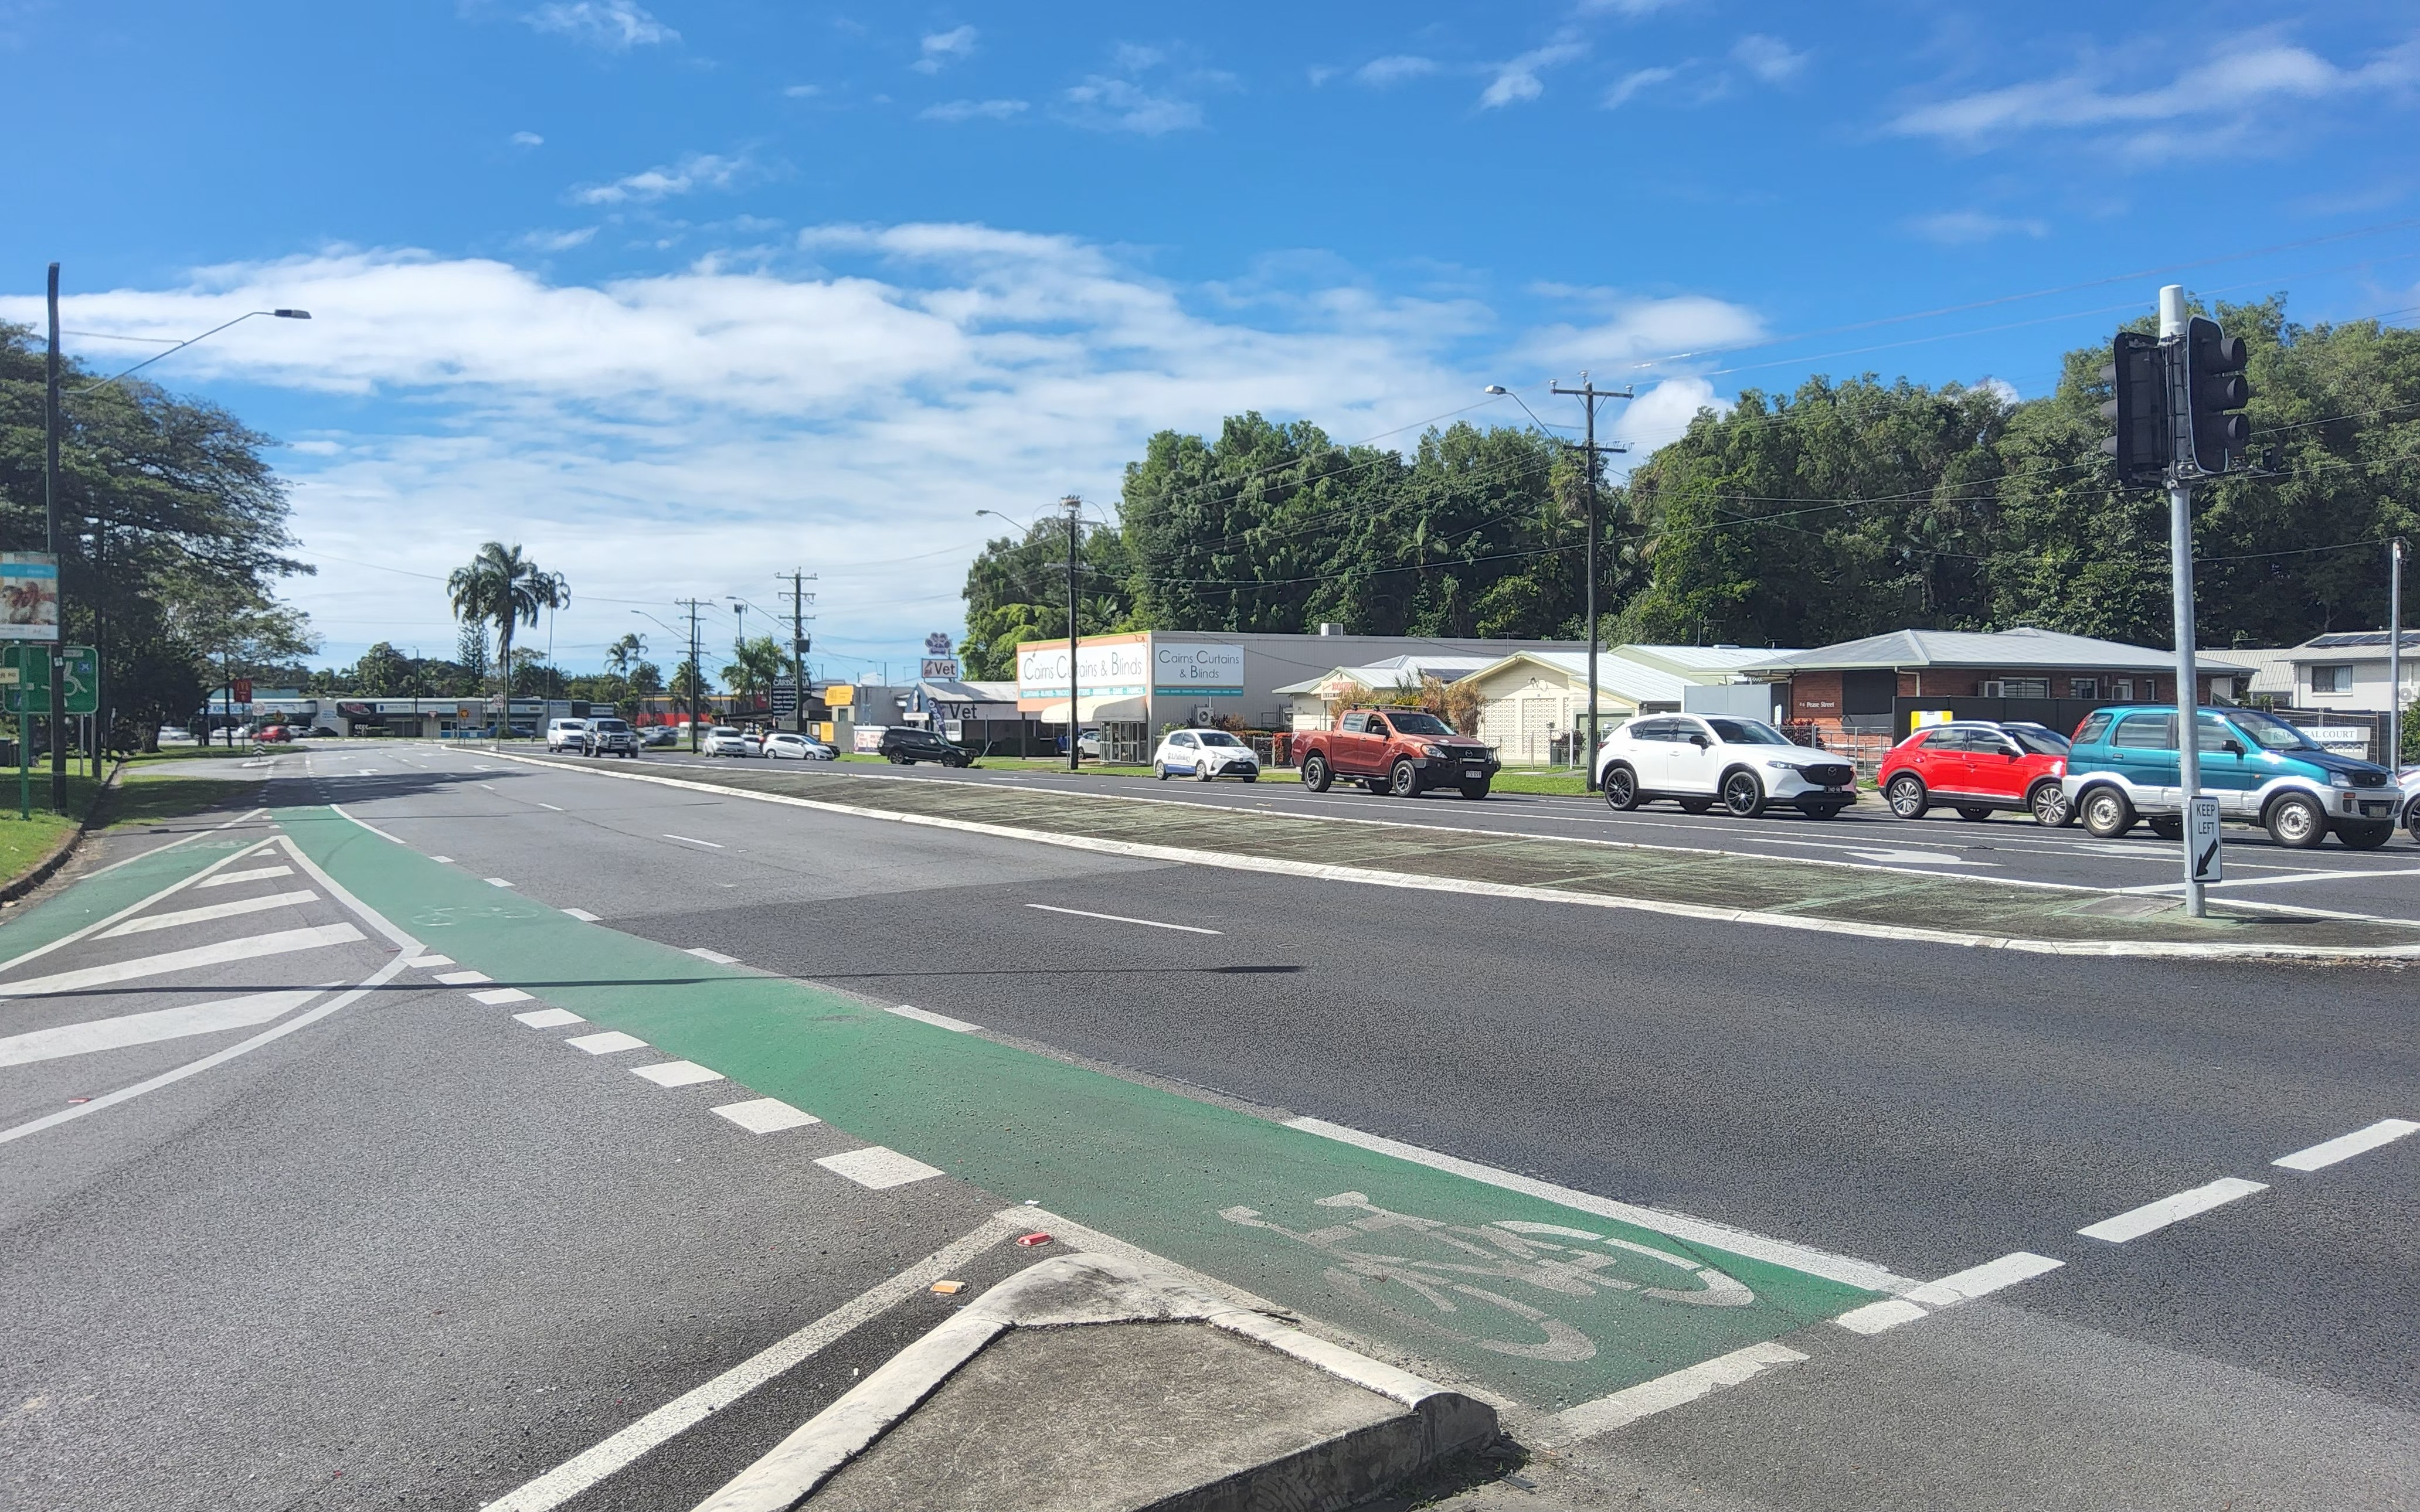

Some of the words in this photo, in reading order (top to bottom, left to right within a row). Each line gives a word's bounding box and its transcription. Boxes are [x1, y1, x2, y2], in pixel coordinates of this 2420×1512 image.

[1159, 650, 1193, 663] Cairns
[1197, 651, 1239, 664] Curtains
[934, 662, 956, 675] Vet
[1024, 658, 1053, 680] Cairns
[1056, 655, 1097, 679] Cuains
[1100, 660, 1107, 676] &
[1112, 652, 1142, 676] Blinds
[1180, 669, 1187, 678] &
[1191, 665, 1219, 679] Blinds
[949, 704, 978, 719] Vet
[2322, 730, 2355, 738] COURT
[2197, 804, 2215, 817] KEEP
[2198, 822, 2214, 835] LEFT
